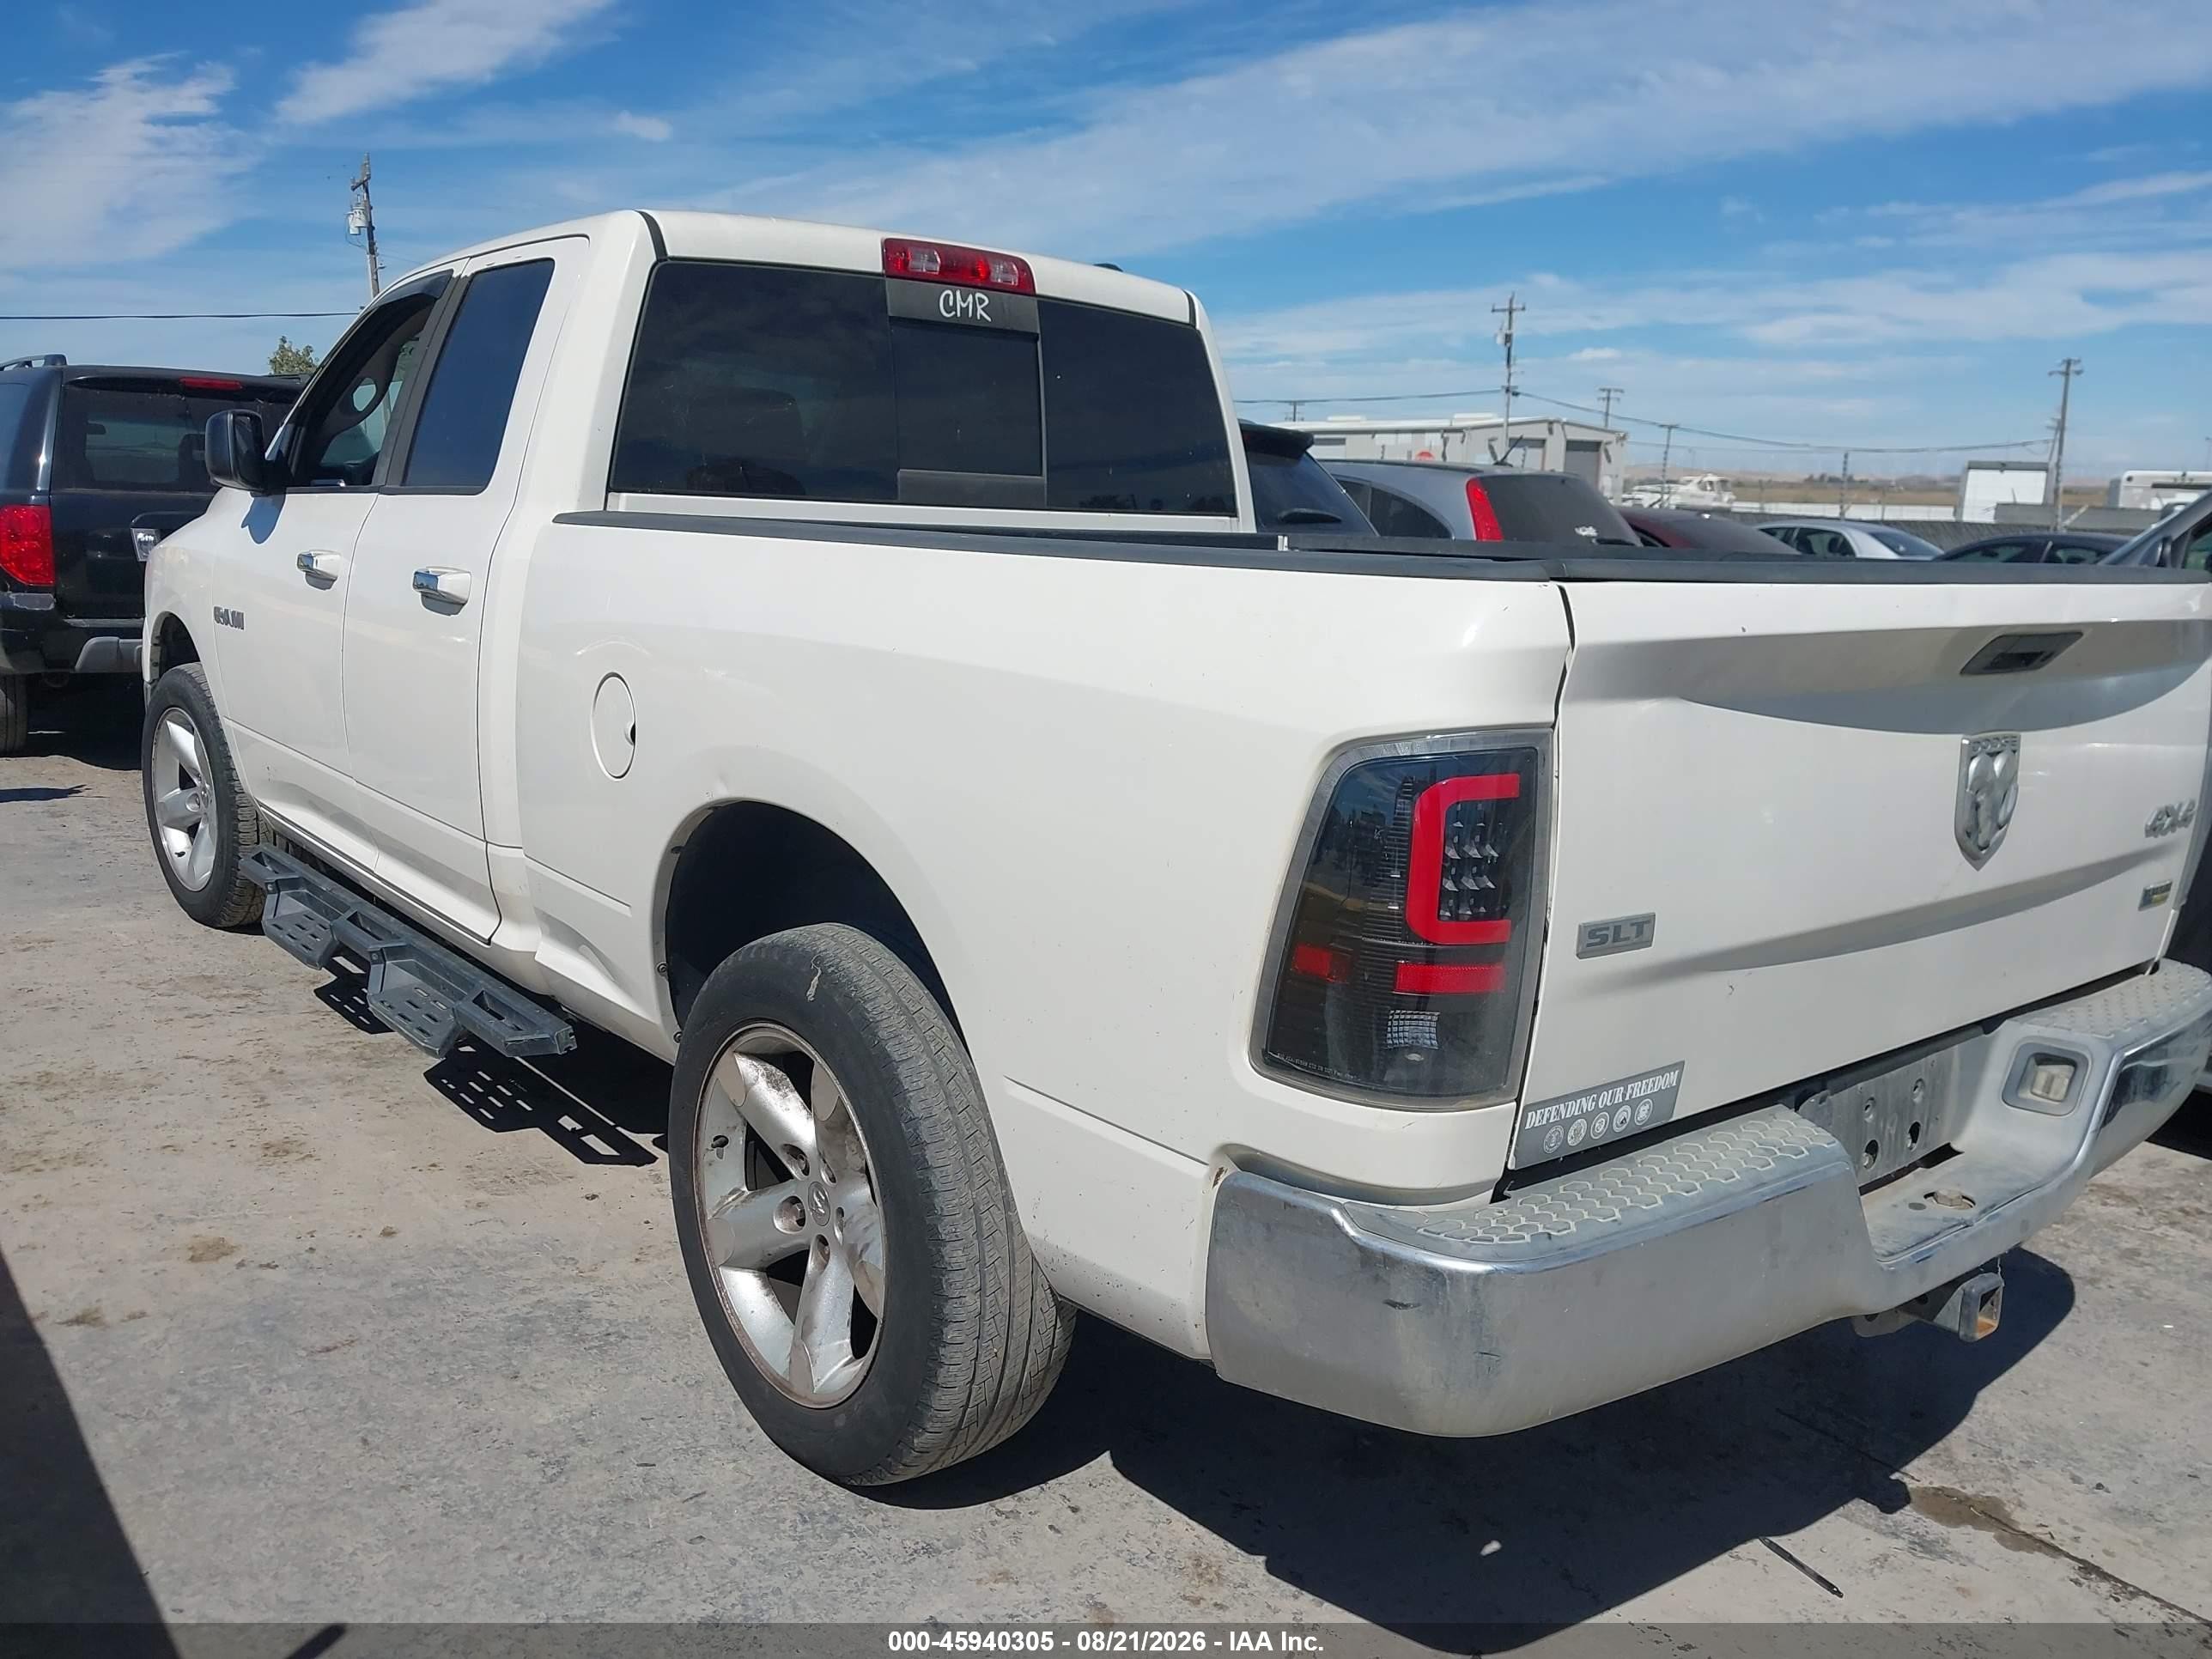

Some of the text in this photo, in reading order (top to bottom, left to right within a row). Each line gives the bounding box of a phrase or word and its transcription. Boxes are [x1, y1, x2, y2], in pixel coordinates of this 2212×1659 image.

[939, 289, 992, 322] CMR
[1586, 919, 1650, 947] SLT
[1525, 1070, 1679, 1129] DEFENDING OUR FREEDOM
